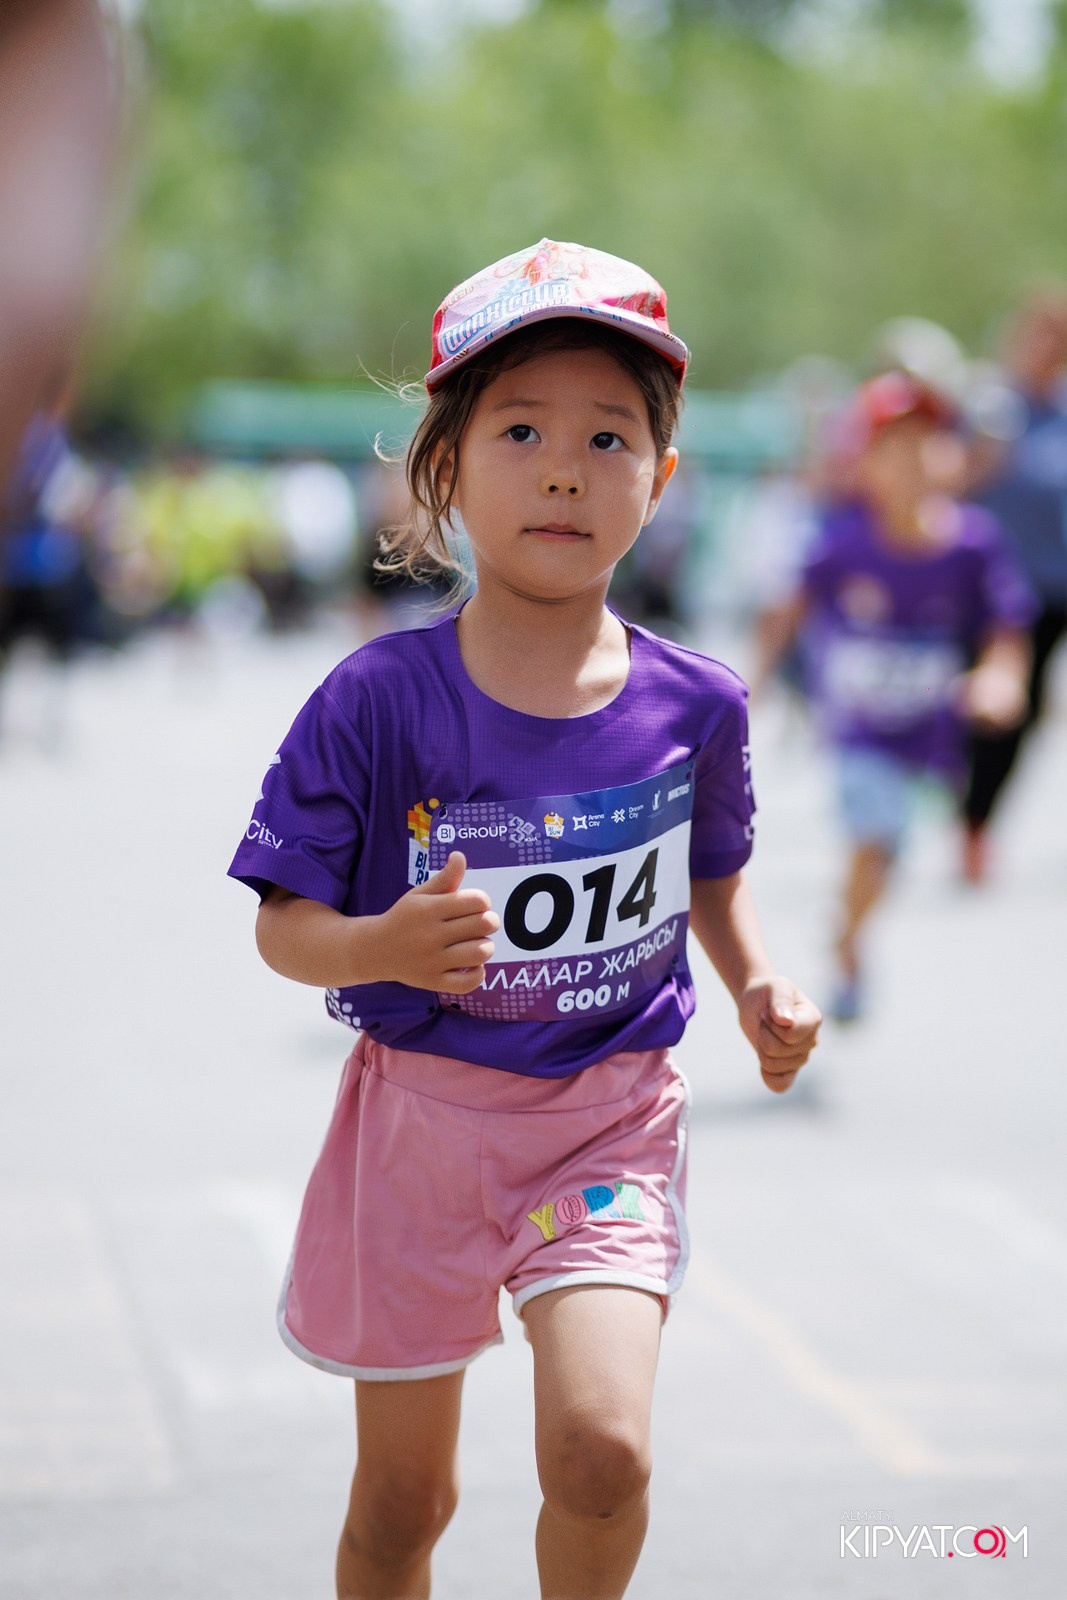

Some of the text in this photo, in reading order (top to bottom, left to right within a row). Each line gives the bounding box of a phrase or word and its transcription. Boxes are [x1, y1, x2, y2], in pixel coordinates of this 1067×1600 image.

[508, 283, 568, 312] CLUB
[588, 813, 605, 821] Arena
[628, 804, 644, 813] Dream
[246, 819, 283, 849] City
[458, 825, 508, 839] GROUP
[415, 851, 428, 870] BI
[599, 919, 679, 979] ЖАРЫСЫ
[556, 984, 612, 1013] 600
